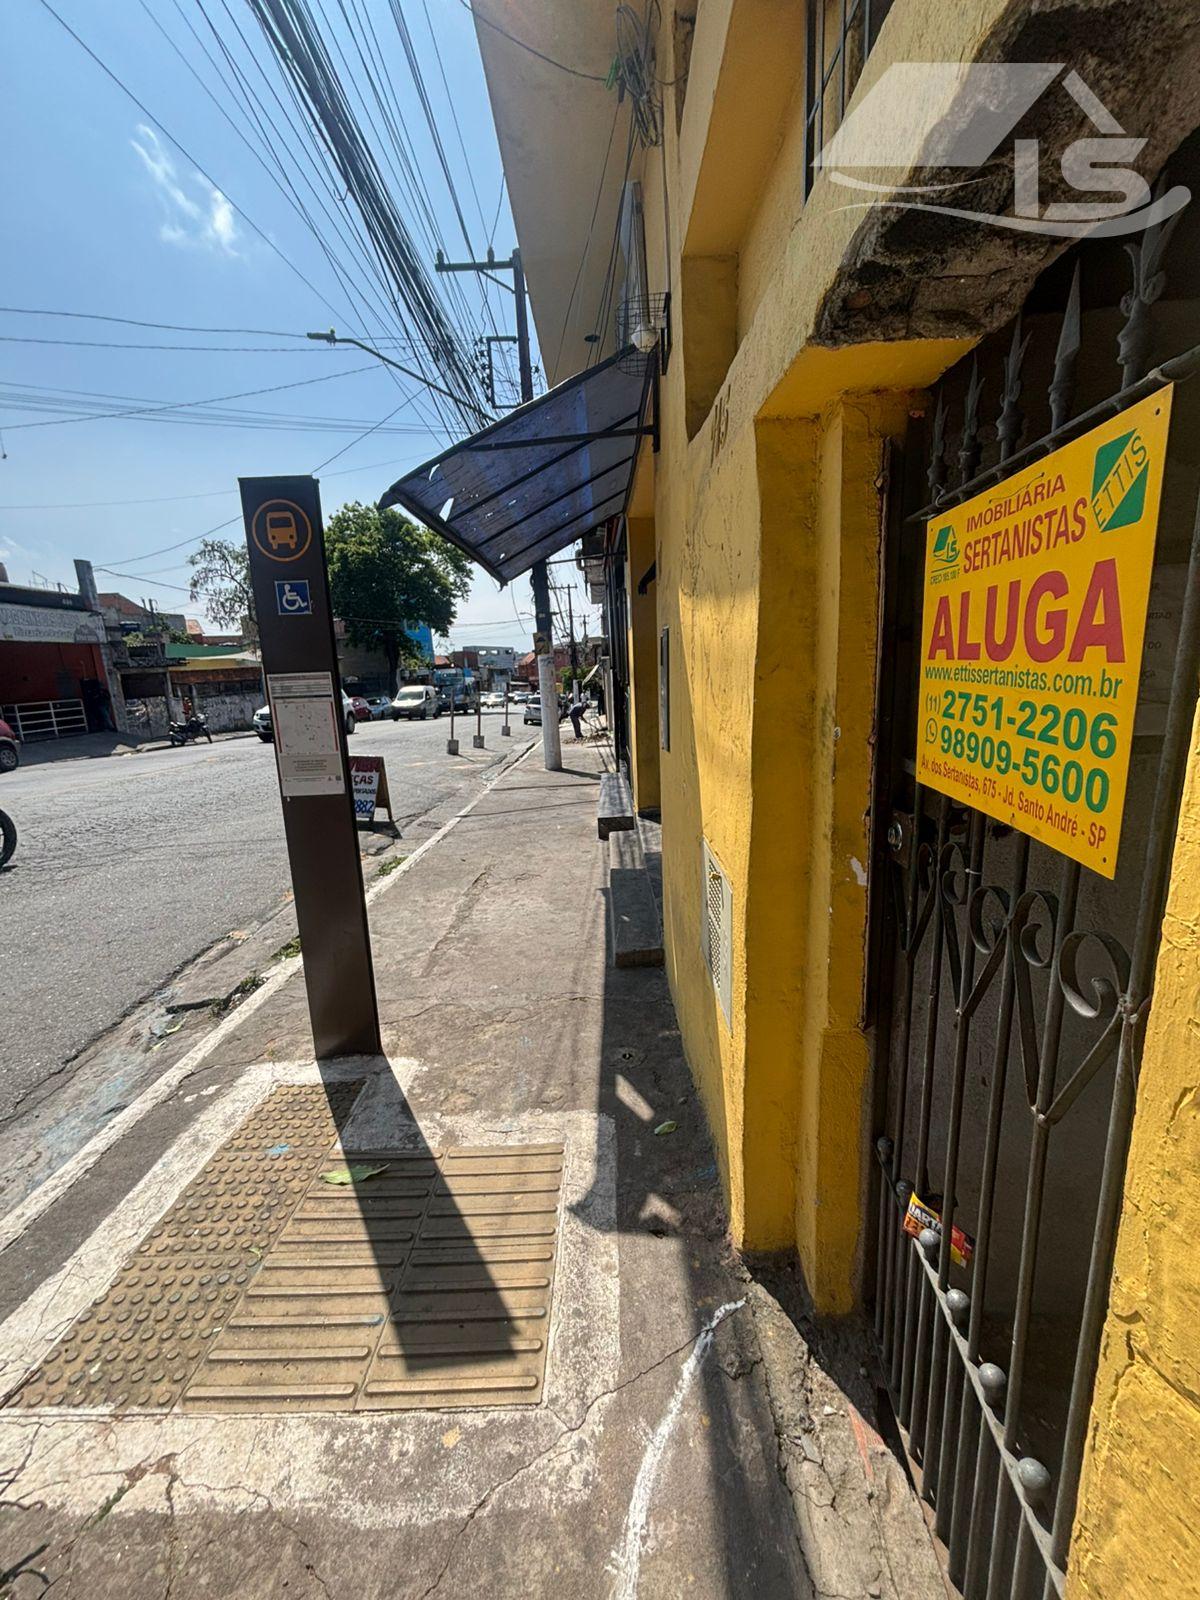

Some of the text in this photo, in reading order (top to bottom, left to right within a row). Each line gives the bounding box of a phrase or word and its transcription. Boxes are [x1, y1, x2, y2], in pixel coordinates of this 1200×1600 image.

[966, 474, 1066, 533] IMOBILIÁRIA
[1092, 436, 1147, 529] ETTIS
[963, 497, 1088, 574] SERTANISTAS
[928, 558, 1126, 664] ALUGA
[925, 662, 1124, 699] www.ettissertanistas.com.br
[925, 690, 1119, 759] (11) 2751-2206
[352, 774, 374, 786] ÇAS
[354, 799, 375, 813] 882
[931, 760, 942, 775] dos
[943, 762, 981, 794] Sertanistas,
[982, 776, 996, 799] 675
[1002, 785, 1015, 807] Jd.
[1017, 791, 1045, 821] Santo
[1046, 804, 1078, 838] André
[1087, 821, 1107, 849] SP
[941, 725, 1110, 814] 98909-5600
